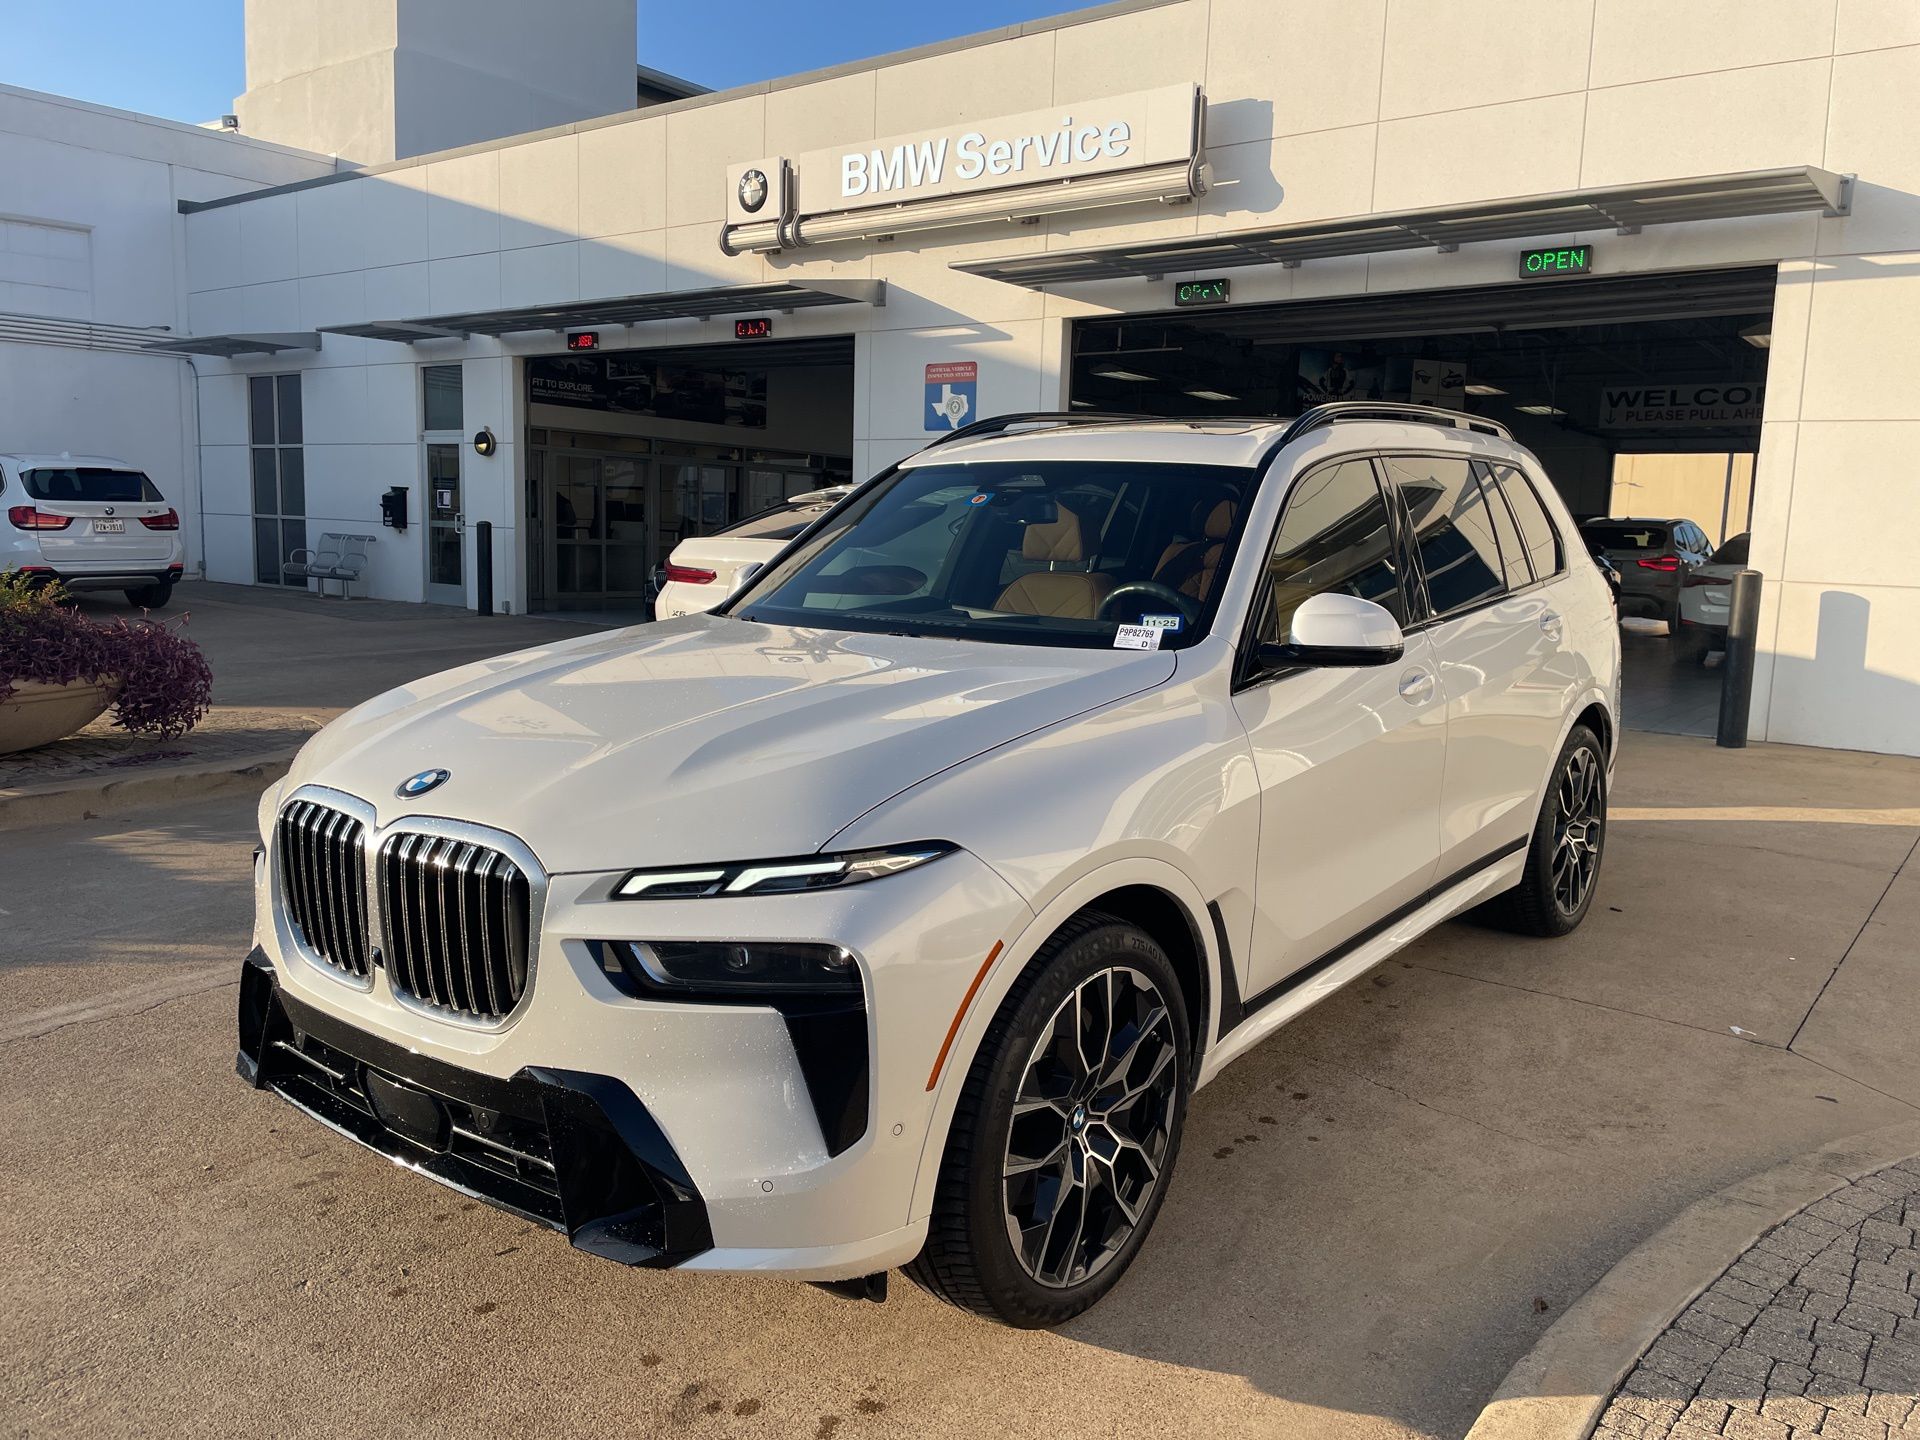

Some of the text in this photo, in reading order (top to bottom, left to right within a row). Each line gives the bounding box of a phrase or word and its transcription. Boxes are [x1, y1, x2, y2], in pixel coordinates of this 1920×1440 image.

[841, 116, 1131, 197] BMW Service
[1526, 249, 1585, 272] OPEN
[545, 379, 557, 388] TO
[1606, 386, 1764, 409] WELCO
[1625, 408, 1763, 422] PLEASE PULL AHE
[1118, 627, 1155, 638] P9P82769
[1141, 640, 1148, 648] D
